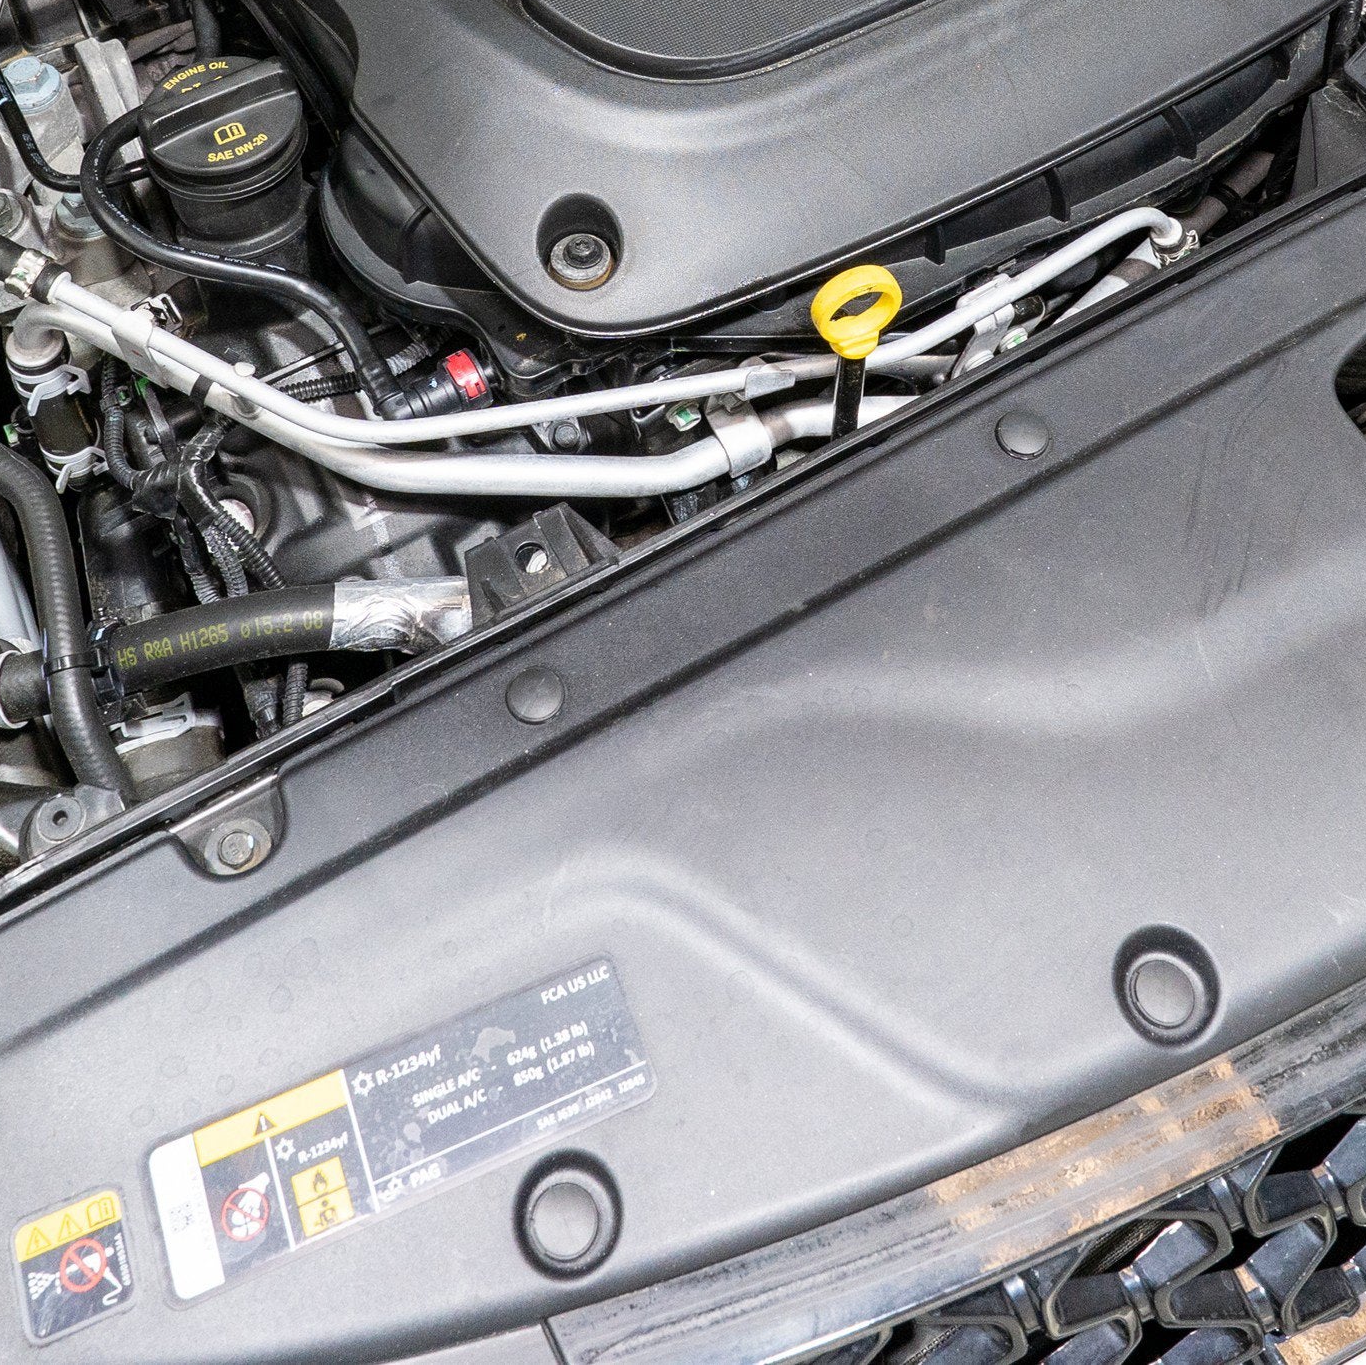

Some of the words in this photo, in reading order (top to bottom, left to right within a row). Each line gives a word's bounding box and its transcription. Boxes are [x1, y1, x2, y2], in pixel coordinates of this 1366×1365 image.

[163, 65, 206, 91] ENGINE
[208, 61, 228, 70] OIL
[207, 151, 234, 163] SAE
[234, 133, 268, 156] 0W-20
[117, 647, 137, 668] HS
[143, 637, 172, 660] R&A
[180, 623, 229, 652] H1265
[302, 610, 324, 629] 08
[541, 985, 567, 1004] FCA
[568, 976, 586, 993] US
[586, 966, 609, 985] LLC
[376, 1045, 442, 1085] R-1234yf
[412, 1079, 458, 1106] SINGLE
[458, 1067, 481, 1088] A/C
[507, 1046, 537, 1067] 624g
[540, 1030, 571, 1052] (1.38
[571, 1021, 589, 1039] lb)
[428, 1099, 462, 1123] DUAL
[463, 1088, 488, 1110] A/C
[514, 1065, 545, 1087] 850g
[546, 1050, 577, 1074] (1.87
[577, 1042, 595, 1060] lb)
[537, 1113, 556, 1129] SAE
[298, 1133, 349, 1163] R-1234yf
[409, 1164, 441, 1186] PAG
